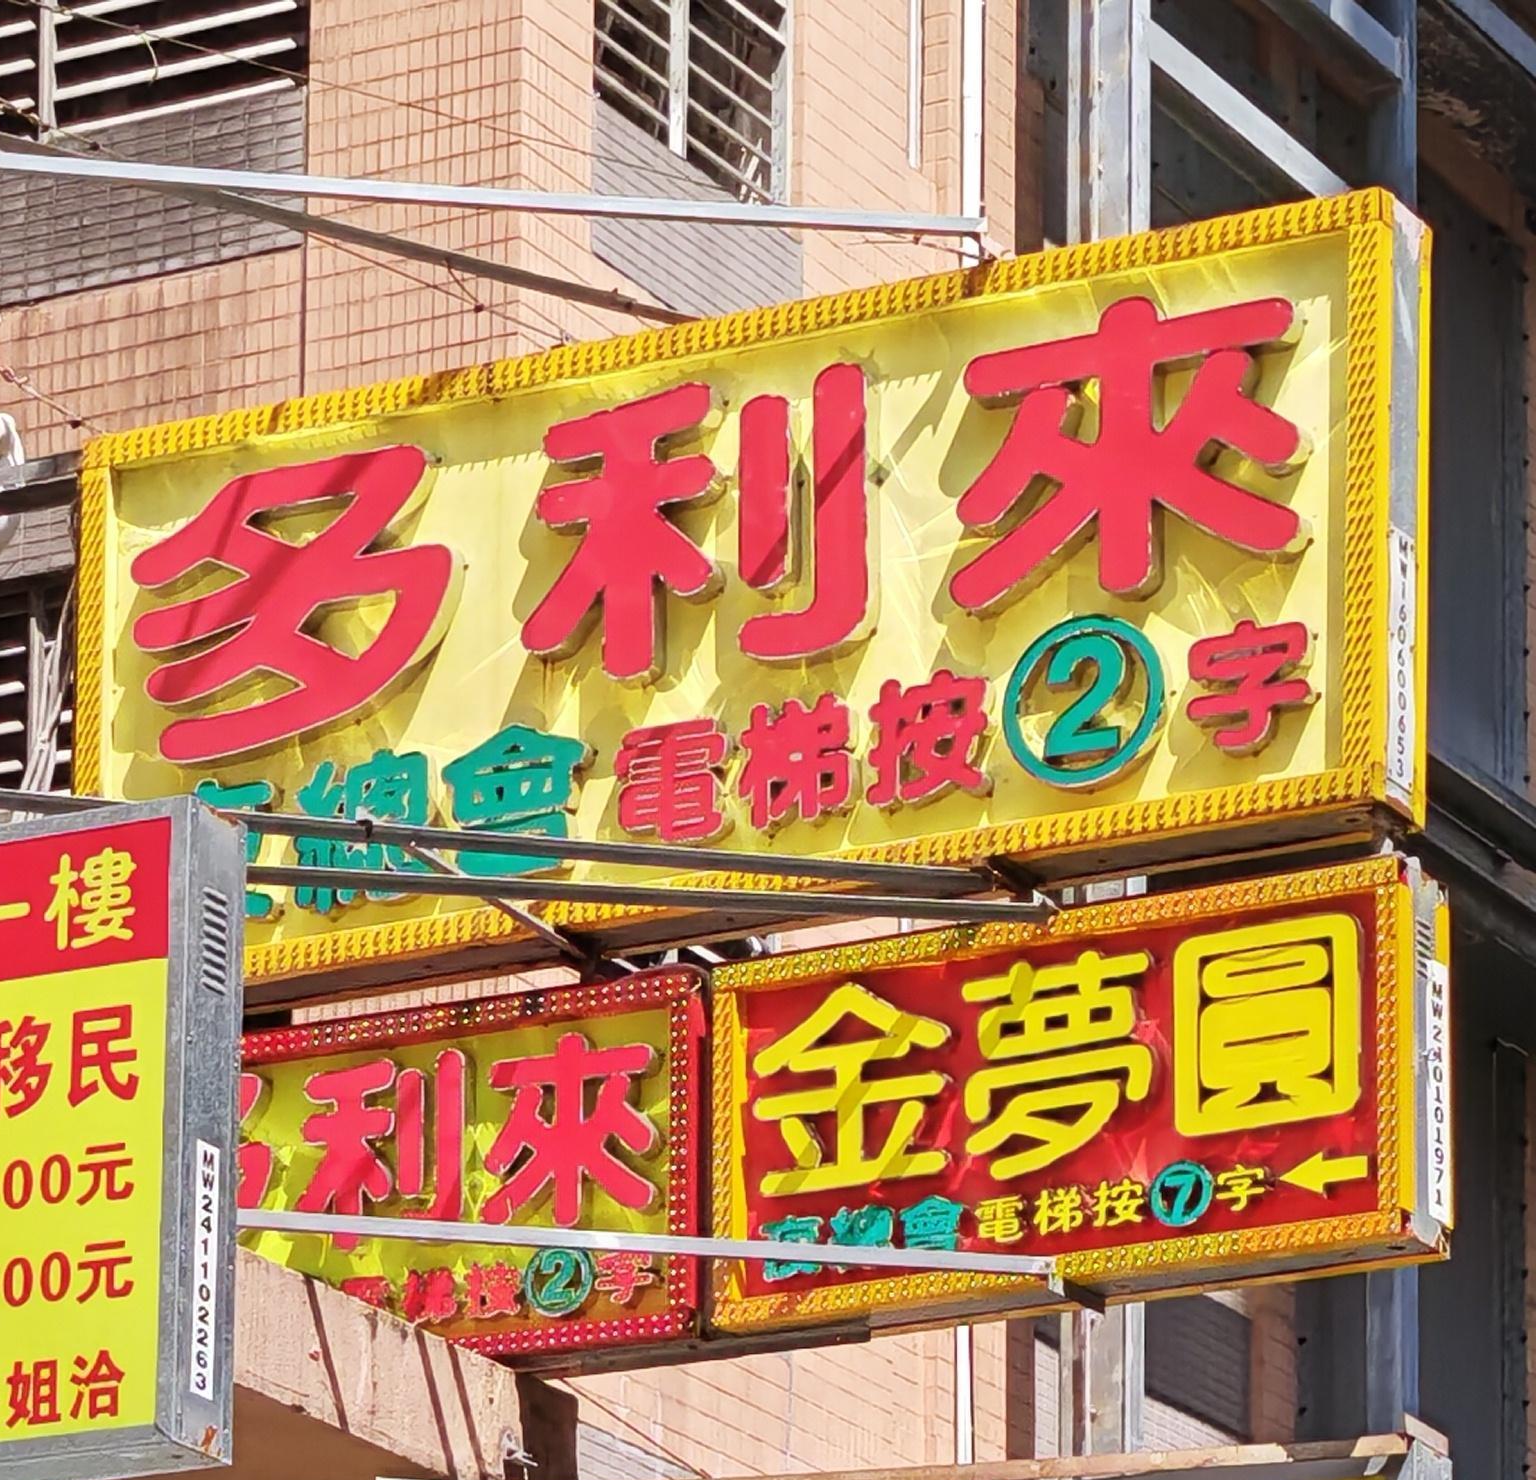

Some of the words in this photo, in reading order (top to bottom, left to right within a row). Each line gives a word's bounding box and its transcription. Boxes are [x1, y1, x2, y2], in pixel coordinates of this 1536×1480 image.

[131, 294, 1309, 763] 多利來
[753, 912, 1363, 1198] 金夢圓
[195, 1150, 215, 1391] MW241102263
